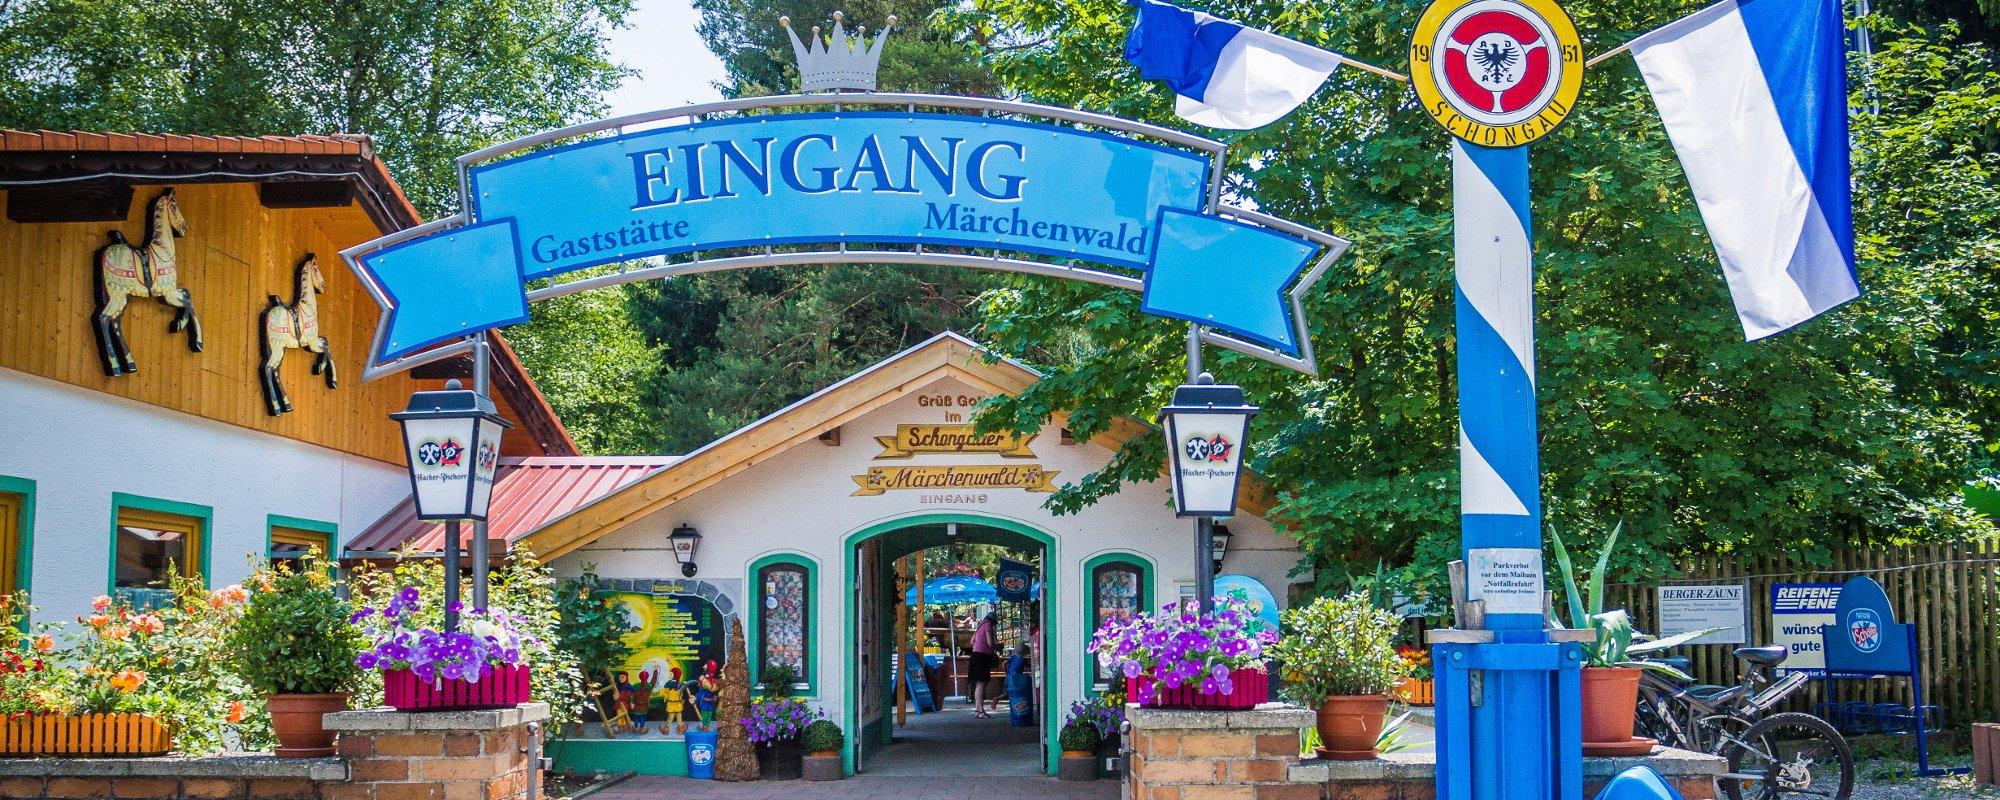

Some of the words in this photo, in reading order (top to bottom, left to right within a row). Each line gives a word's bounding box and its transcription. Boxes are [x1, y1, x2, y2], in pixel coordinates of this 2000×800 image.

[1411, 43, 1430, 63] 19
[1562, 44, 1579, 63] 51
[1430, 100, 1567, 146] SCHONGAU
[625, 133, 1029, 212] EINGANG
[923, 202, 1148, 256] Märchenwald
[531, 219, 690, 264] Gaststätte
[917, 393, 953, 408] Grüß
[957, 395, 982, 407] Go
[944, 410, 962, 423] im
[885, 466, 1024, 489] Märchenwald
[919, 494, 989, 505] EINGANG
[1492, 562, 1530, 570] Parkverbot
[1662, 587, 1741, 599] BERGER-ZÄUNE
[1777, 587, 1832, 599] REIFEN
[1782, 623, 1824, 635] wünsc
[1791, 641, 1821, 655] gute
